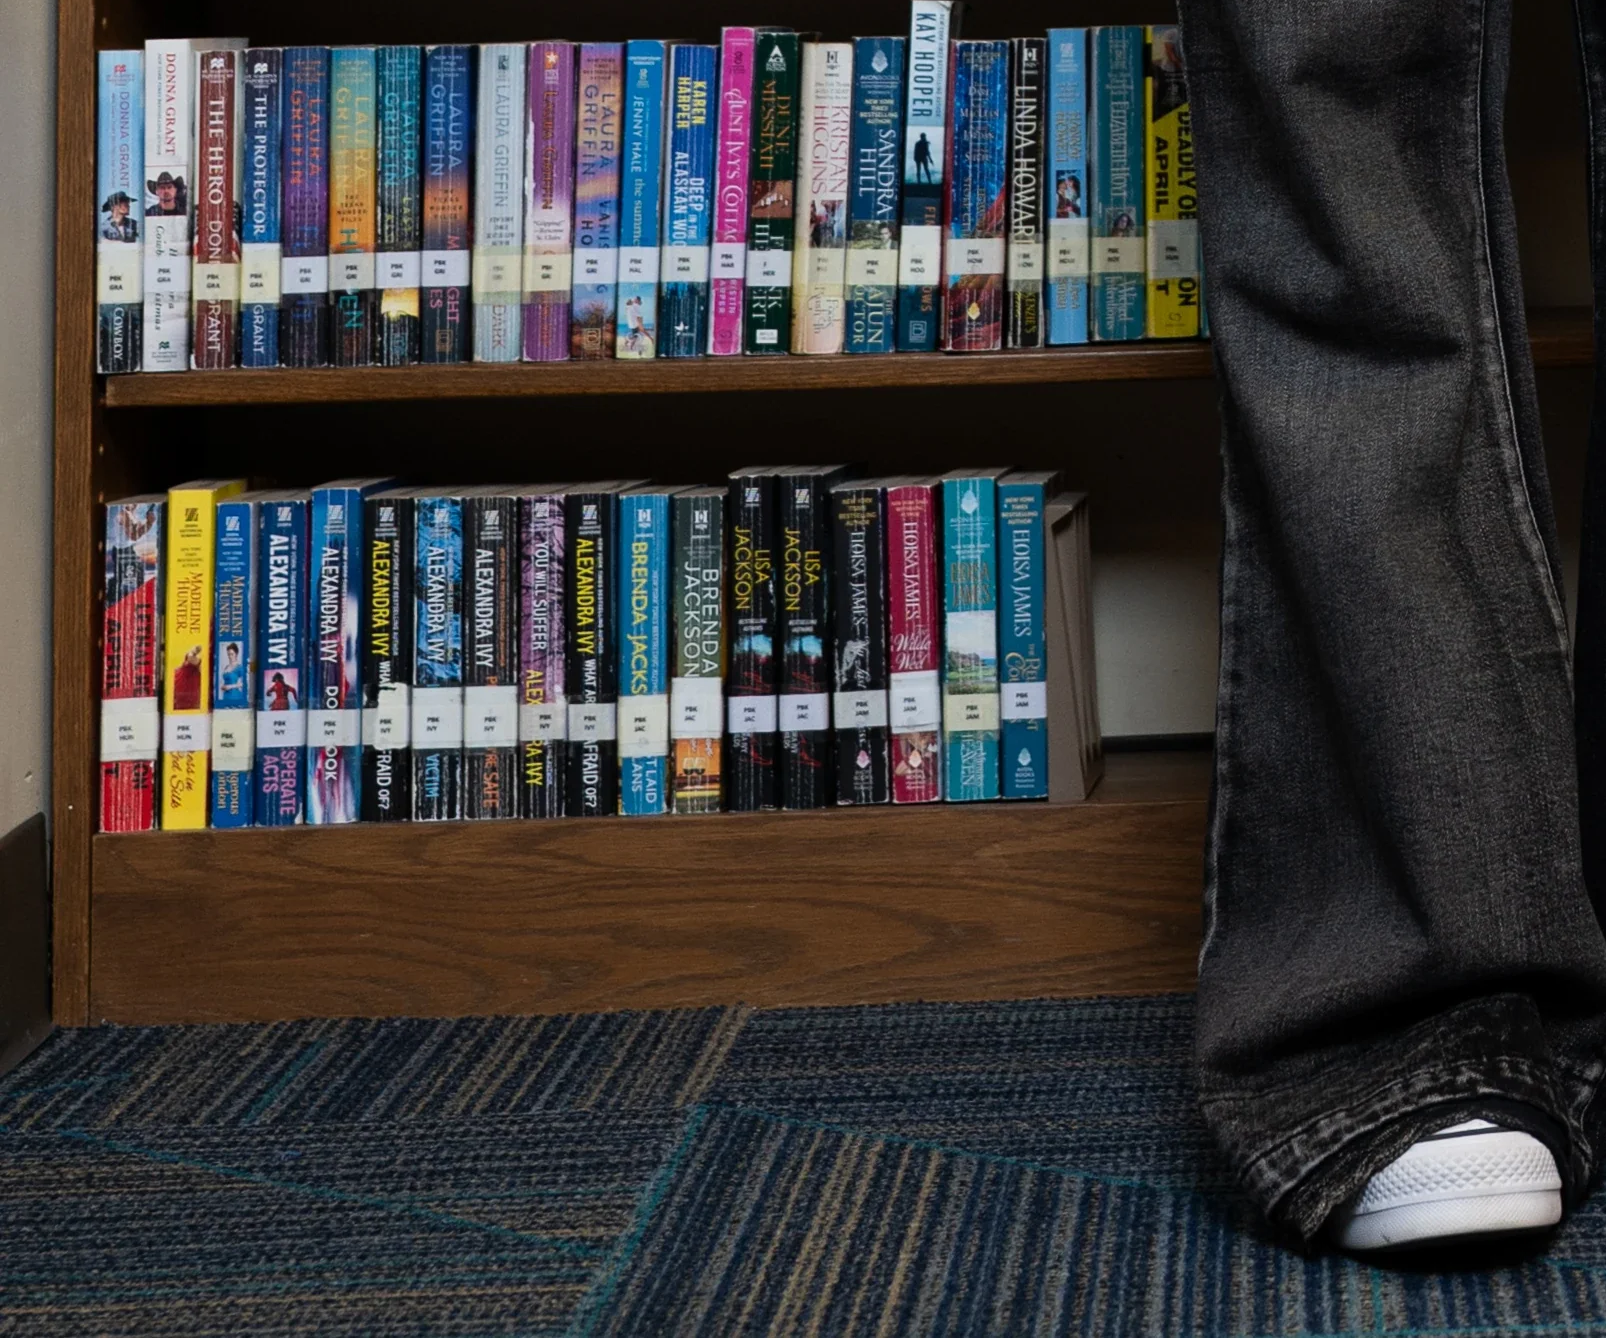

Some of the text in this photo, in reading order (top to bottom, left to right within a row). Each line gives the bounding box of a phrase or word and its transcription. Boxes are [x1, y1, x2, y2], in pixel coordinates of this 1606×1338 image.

[676, 77, 691, 128] HARPER
[692, 81, 706, 124] KAREN
[912, 12, 935, 117] KAY HOOPER
[208, 97, 224, 204] THE HERO
[253, 95, 268, 235] THE PROTECTOR
[760, 81, 775, 169] MESSIAH
[775, 95, 792, 154] DUNE
[673, 151, 689, 213] ALASKAN
[689, 178, 704, 211] DEEP
[269, 534, 288, 665] ALEXANDRA IVY
[532, 542, 546, 650] YOU WILL SUFFER
[784, 527, 801, 610] JACKSON
[804, 550, 820, 584] LISA
[1013, 529, 1031, 637] ELOISA JAMES
